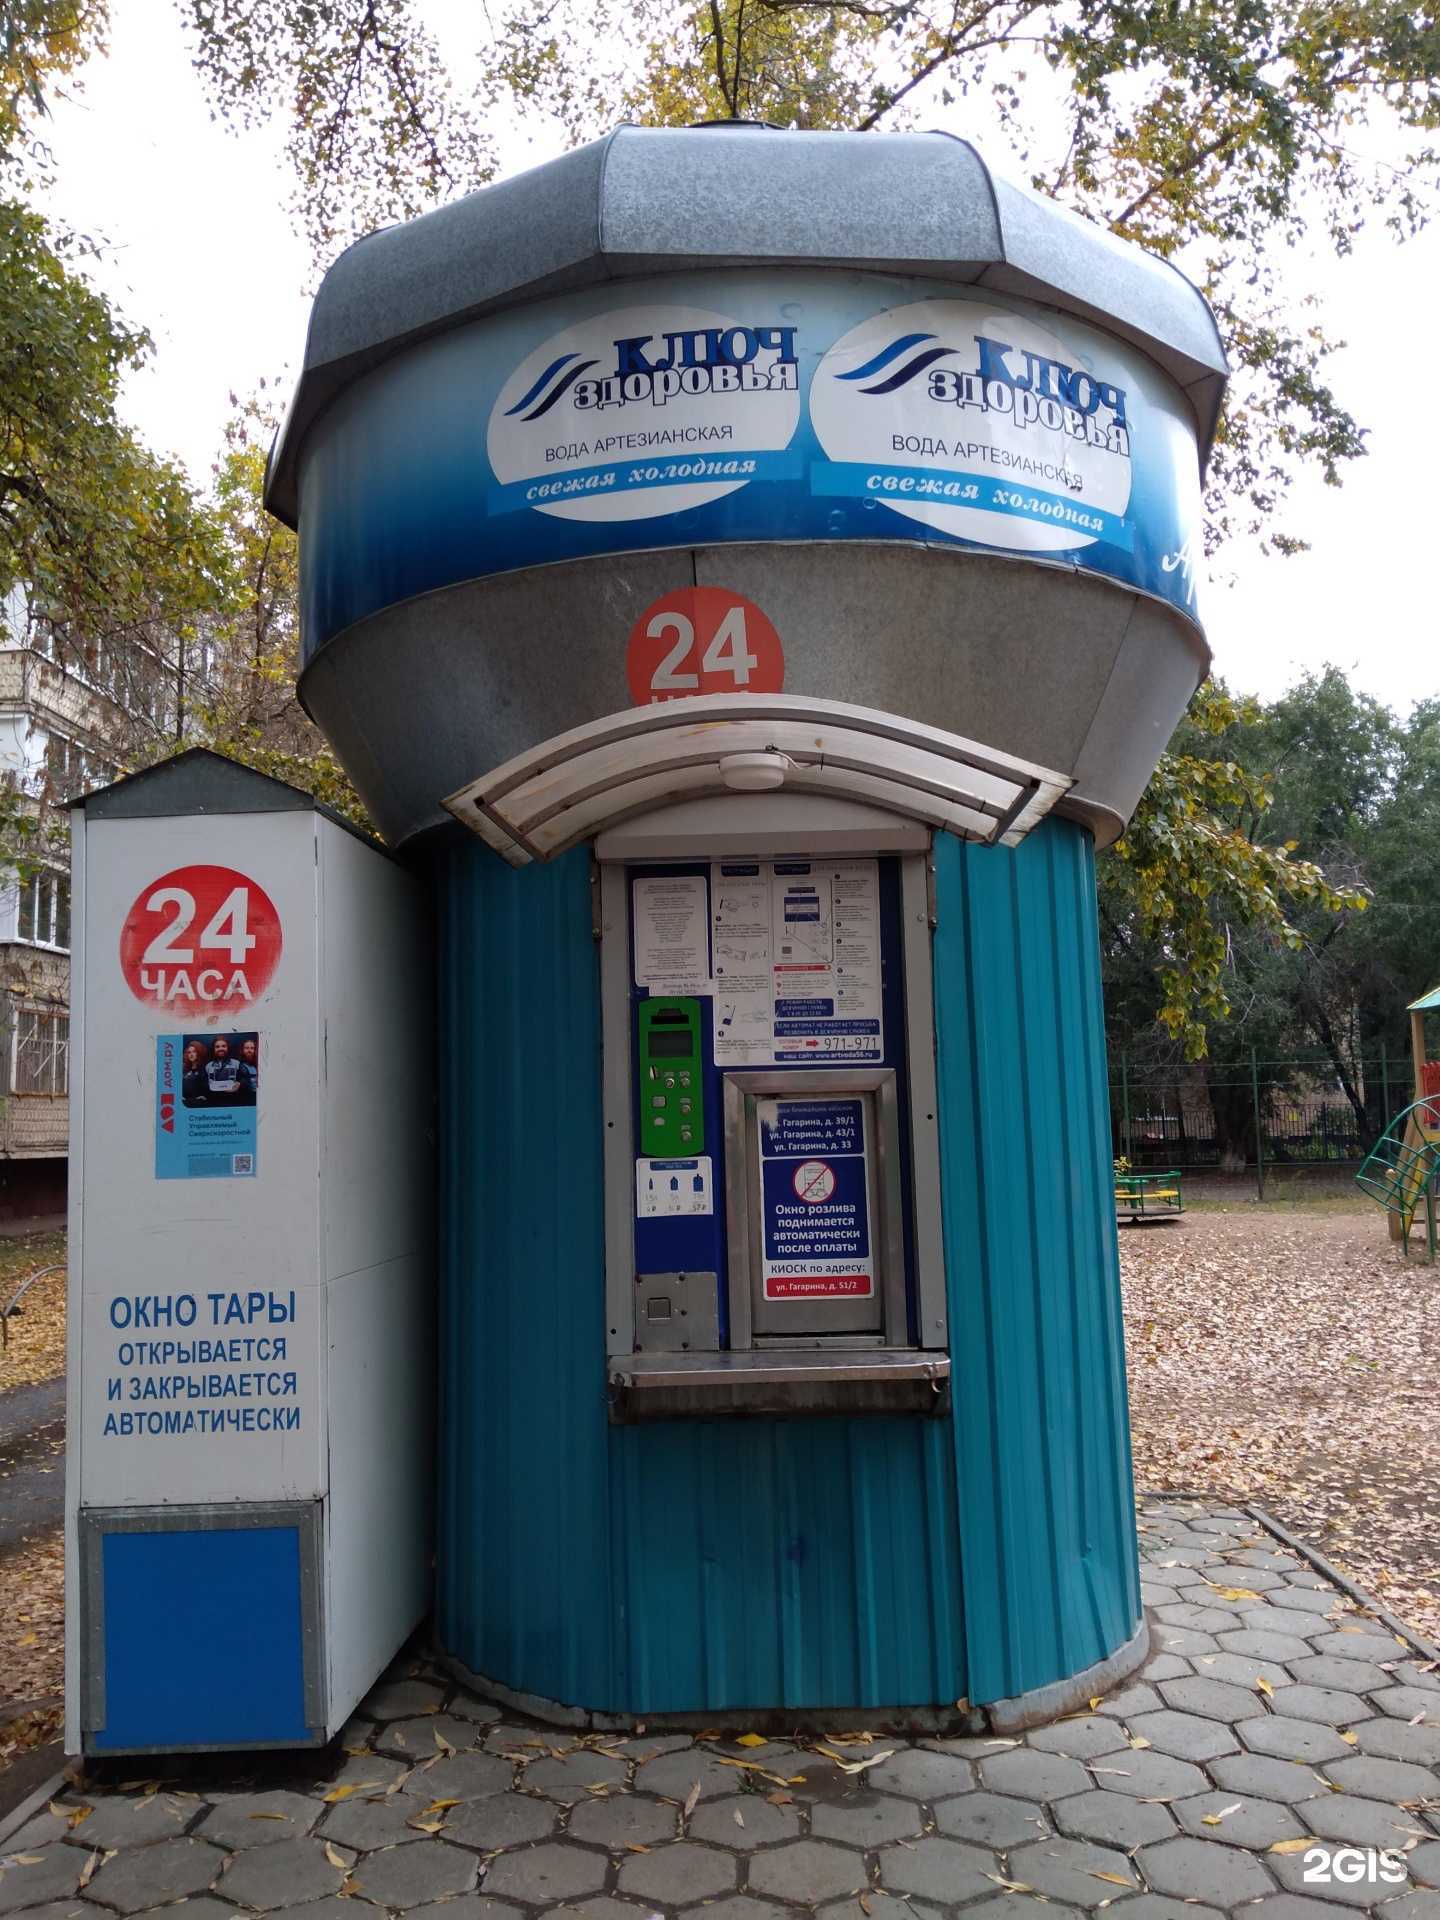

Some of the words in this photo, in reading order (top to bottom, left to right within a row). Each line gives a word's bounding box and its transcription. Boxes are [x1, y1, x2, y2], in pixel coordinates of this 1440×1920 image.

[613, 326, 798, 376] КЛЮЧ
[973, 335, 1127, 424] КЛЮЧ
[545, 442, 590, 463] ВОДА
[594, 425, 733, 454] АРТЕЗИАНСКАЯ
[892, 434, 948, 456] ВОДА
[953, 441, 1084, 489] АРТЕЗИАНСКАЯ
[526, 470, 617, 500] свежая
[628, 457, 758, 483] холодная
[866, 474, 980, 500] свежая
[991, 486, 1104, 532] холодная
[647, 606, 758, 690] 24
[142, 887, 256, 964] 24
[140, 970, 252, 1001] ЧАСА
[824, 1037, 877, 1050] 971-971
[769, 1132, 782, 1140] ул.
[783, 1130, 823, 1139] Гагарина,
[825, 1130, 834, 1138] д.
[836, 1128, 855, 1137] 43/1
[783, 1118, 823, 1127] Гагарина,
[835, 1116, 855, 1125] 39/1
[774, 1144, 786, 1152] ул.
[788, 1142, 829, 1151] Гагарина,
[841, 1140, 852, 1149] 33
[775, 1204, 806, 1215] Окно
[808, 1204, 856, 1216] розлива
[778, 1217, 855, 1229] поднимается
[773, 1230, 861, 1241] автоматически
[777, 1245, 811, 1253] после
[814, 1243, 857, 1252] оплаты
[771, 1264, 807, 1274] КИОСК
[809, 1265, 823, 1273] по
[825, 1264, 866, 1274] адресу:
[776, 1284, 788, 1292] ул.
[789, 1282, 828, 1291] Гагарина,
[839, 1281, 857, 1289] 51/2
[109, 1294, 198, 1329] ОКНО
[207, 1291, 296, 1326] ТАРЫ
[118, 1337, 287, 1366] ОТКРЫВАЕТСЯ
[107, 1377, 122, 1401] И
[129, 1372, 297, 1401] ЗАКРЫВАЕТСЯ
[103, 1406, 301, 1436] АВТОМАТИЧЕСКИ
